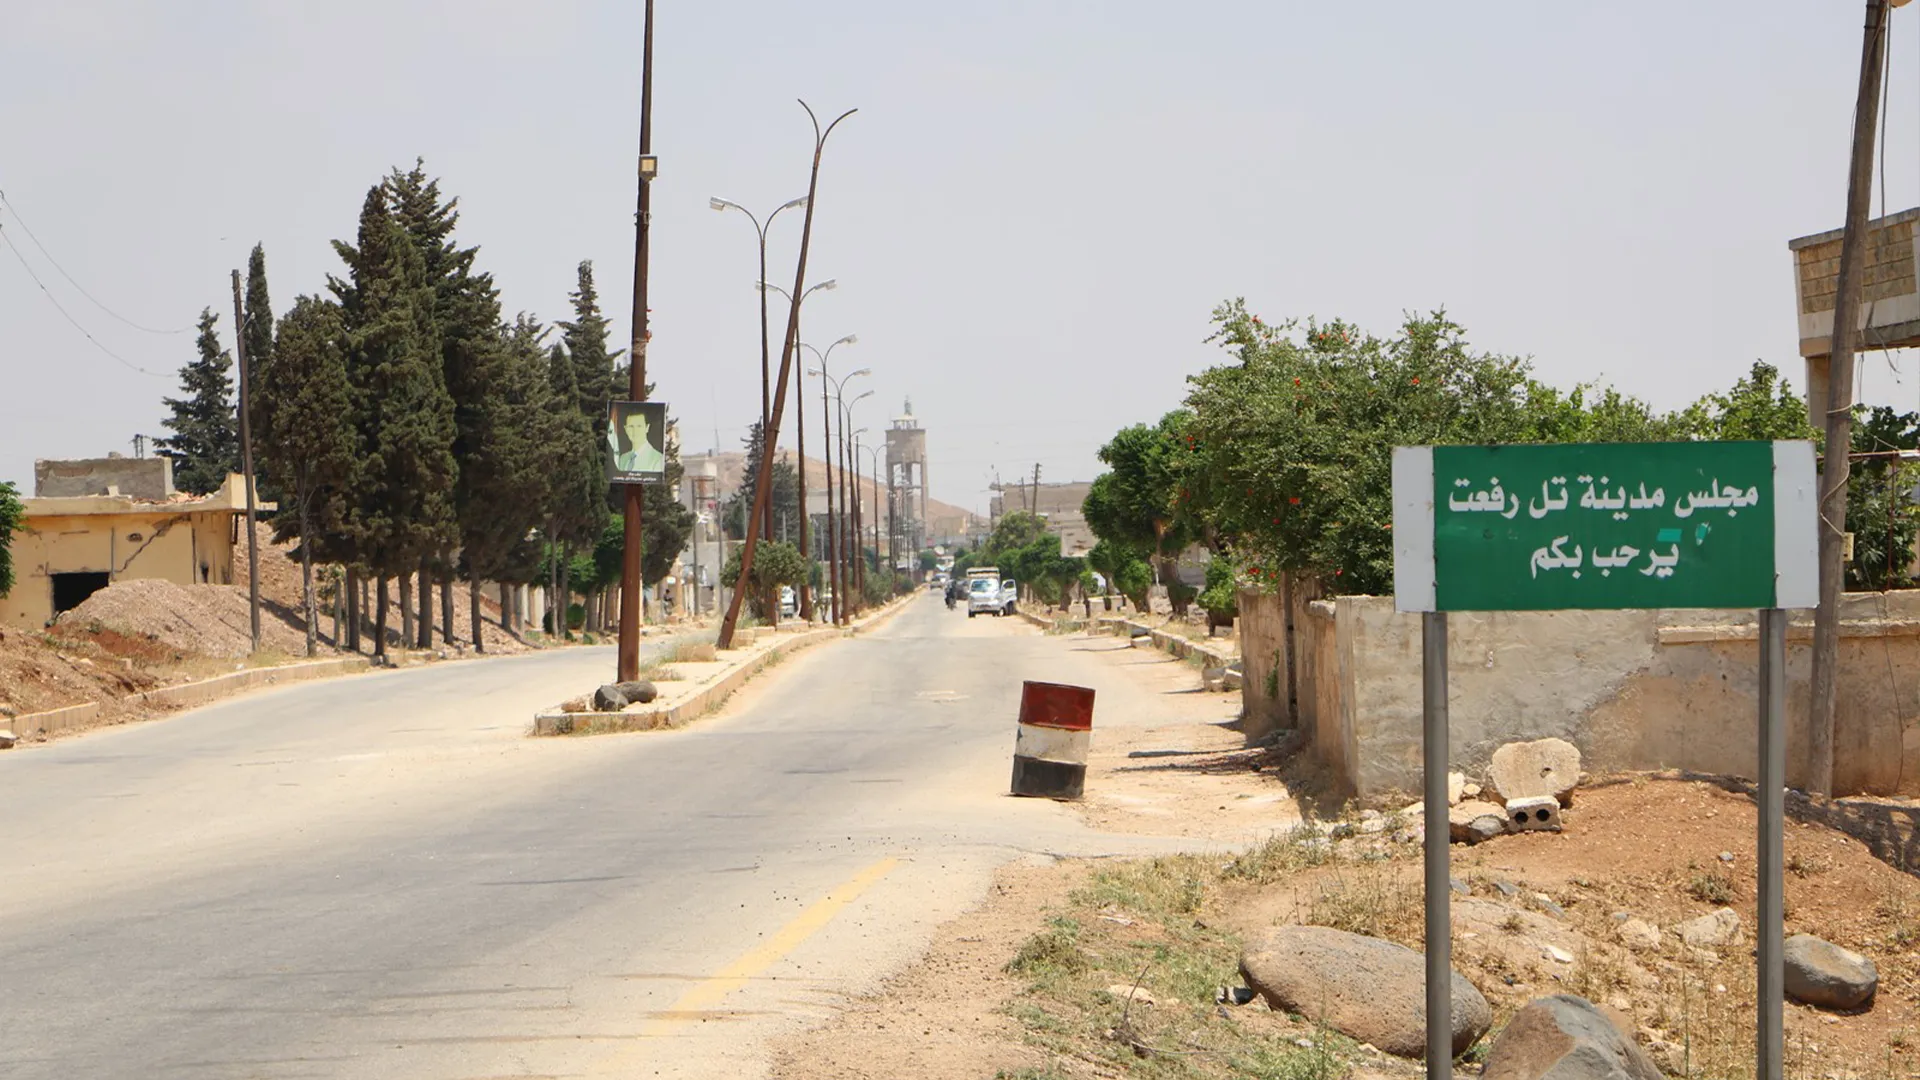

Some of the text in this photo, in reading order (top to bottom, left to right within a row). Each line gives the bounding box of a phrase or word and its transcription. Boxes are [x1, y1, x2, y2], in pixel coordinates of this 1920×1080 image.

[1449, 475, 1759, 520] مجلس مدينة تل رفعت
[1530, 535, 1680, 580] يرحب بكم
